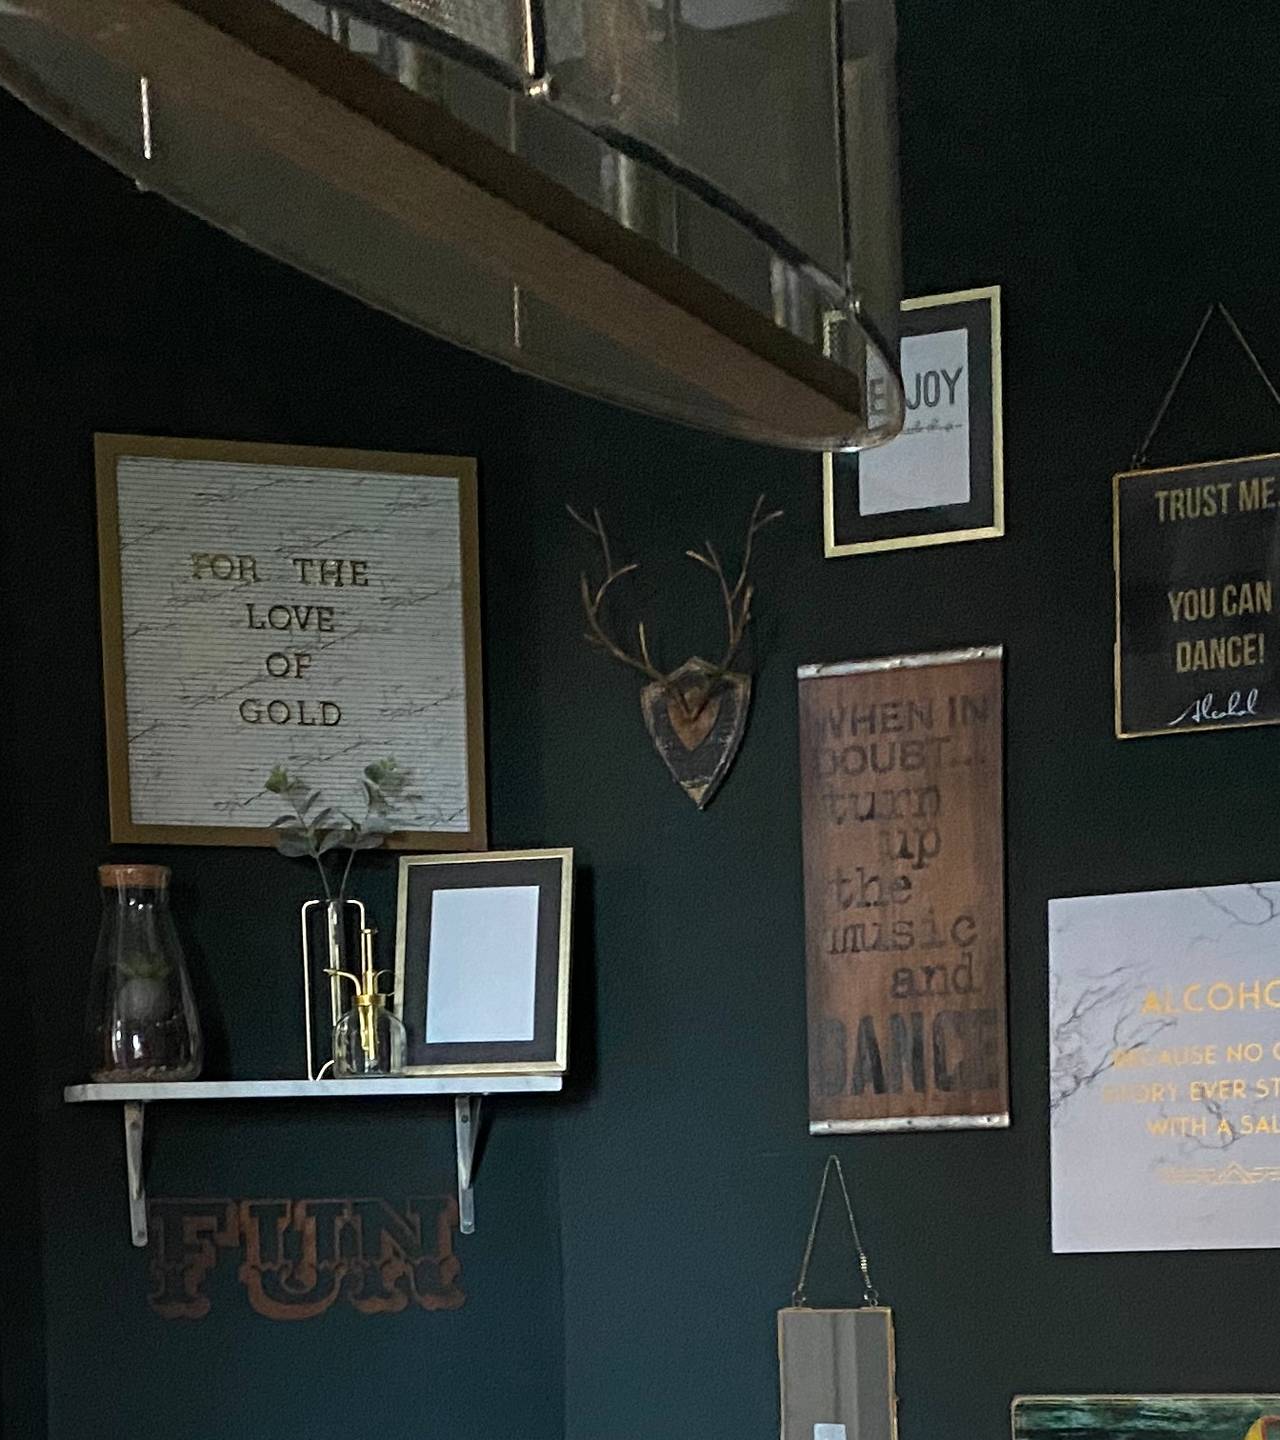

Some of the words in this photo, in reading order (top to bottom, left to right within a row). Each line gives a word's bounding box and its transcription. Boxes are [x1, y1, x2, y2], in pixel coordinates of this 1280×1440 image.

[871, 366, 963, 414] EJOY
[1155, 483, 1232, 522] TRUST
[191, 552, 260, 583] FOR
[292, 557, 369, 588] THE
[246, 603, 335, 632] LOVE
[1168, 588, 1214, 623] YOU
[1222, 581, 1273, 617] CAN
[265, 652, 313, 678] OF
[1176, 633, 1264, 673] DANCE!
[239, 699, 342, 727] GOLD
[820, 702, 933, 738] WHEN
[948, 695, 989, 728] IN
[822, 785, 941, 825] turn
[882, 827, 941, 870] up
[829, 867, 912, 909] the
[830, 906, 978, 954] music
[892, 952, 980, 999] and
[816, 1008, 999, 1096] DANCE
[1226, 1043, 1263, 1063] NO
[1102, 1083, 1177, 1105] ORY
[1190, 1079, 1246, 1102] EVER
[1145, 1116, 1207, 1138] WITH
[1217, 1116, 1232, 1135] A
[146, 1197, 466, 1321] FUN
